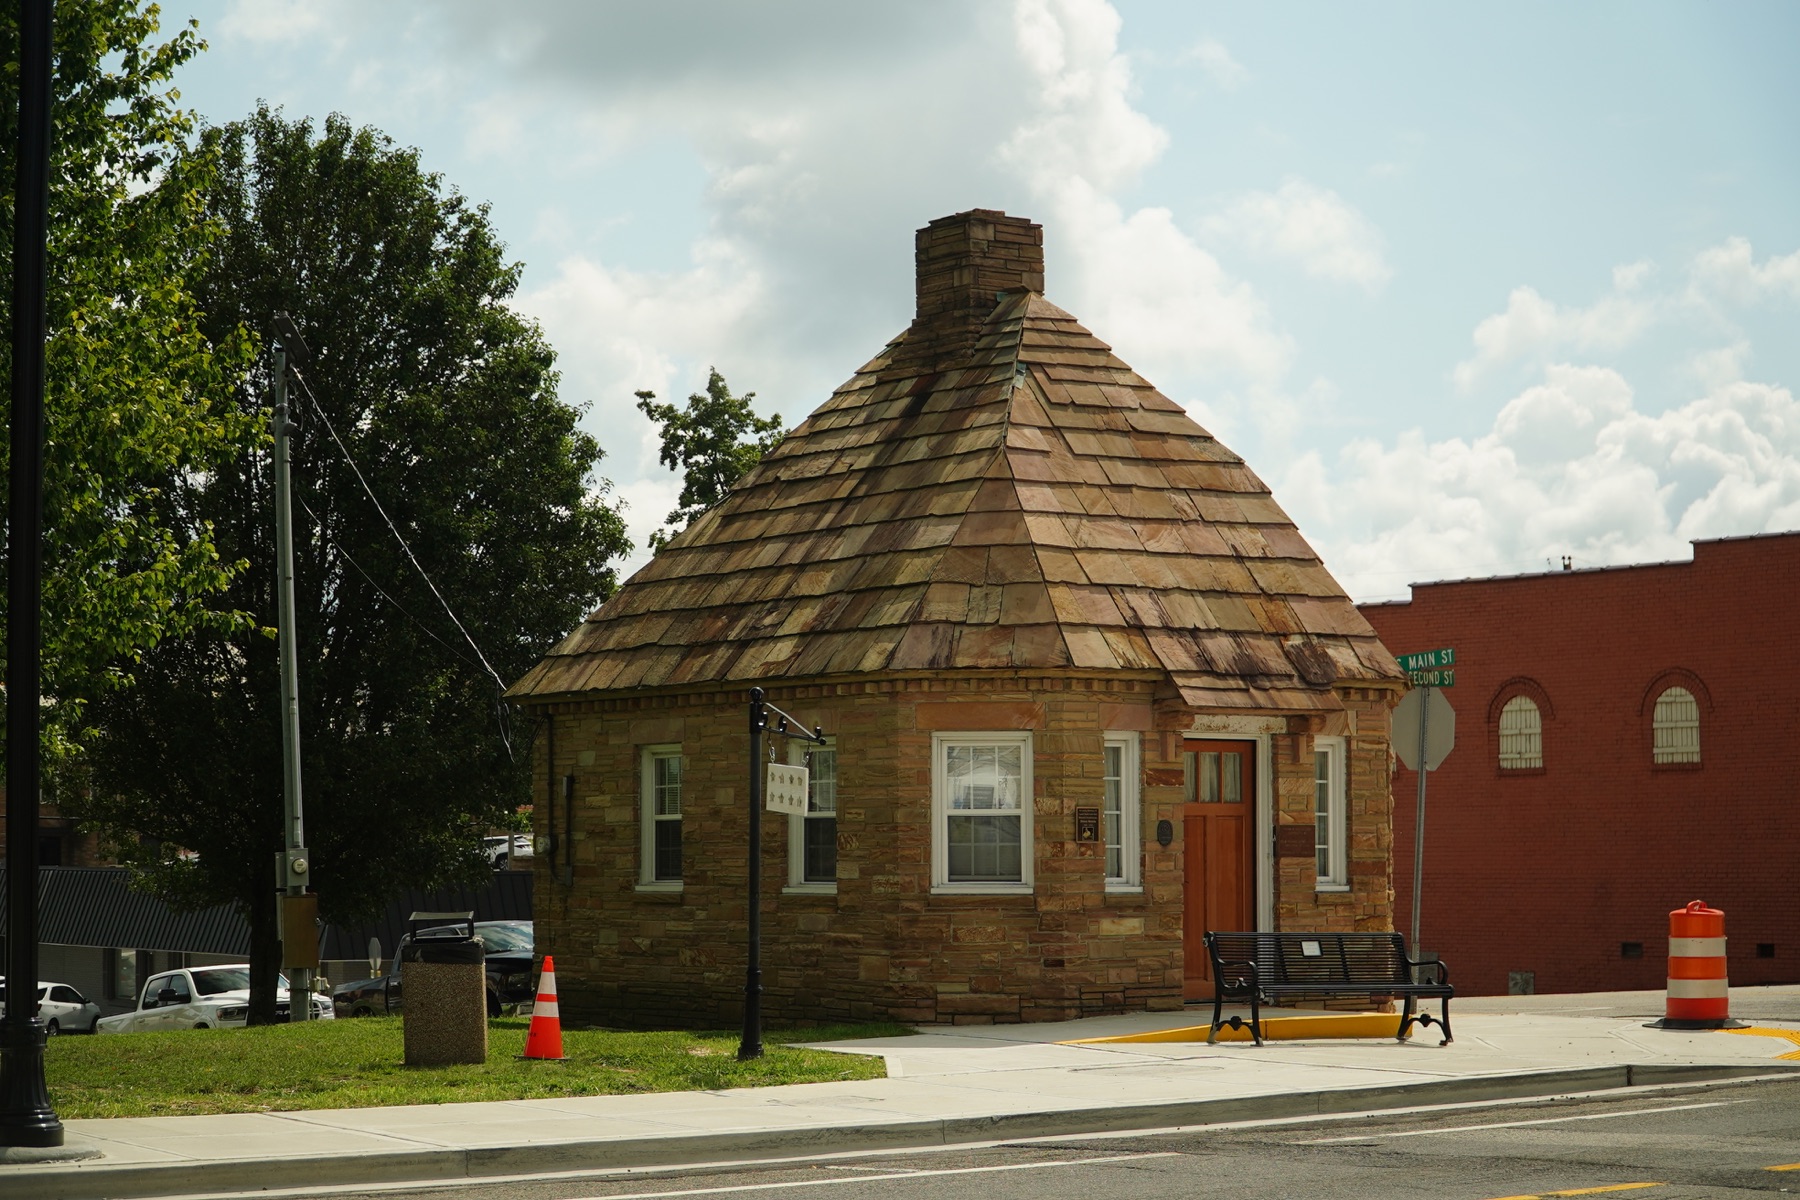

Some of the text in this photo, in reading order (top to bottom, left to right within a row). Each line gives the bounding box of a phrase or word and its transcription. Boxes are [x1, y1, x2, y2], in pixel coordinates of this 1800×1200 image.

[1408, 649, 1453, 670] MAIN ST
[1444, 671, 1453, 684] ST
